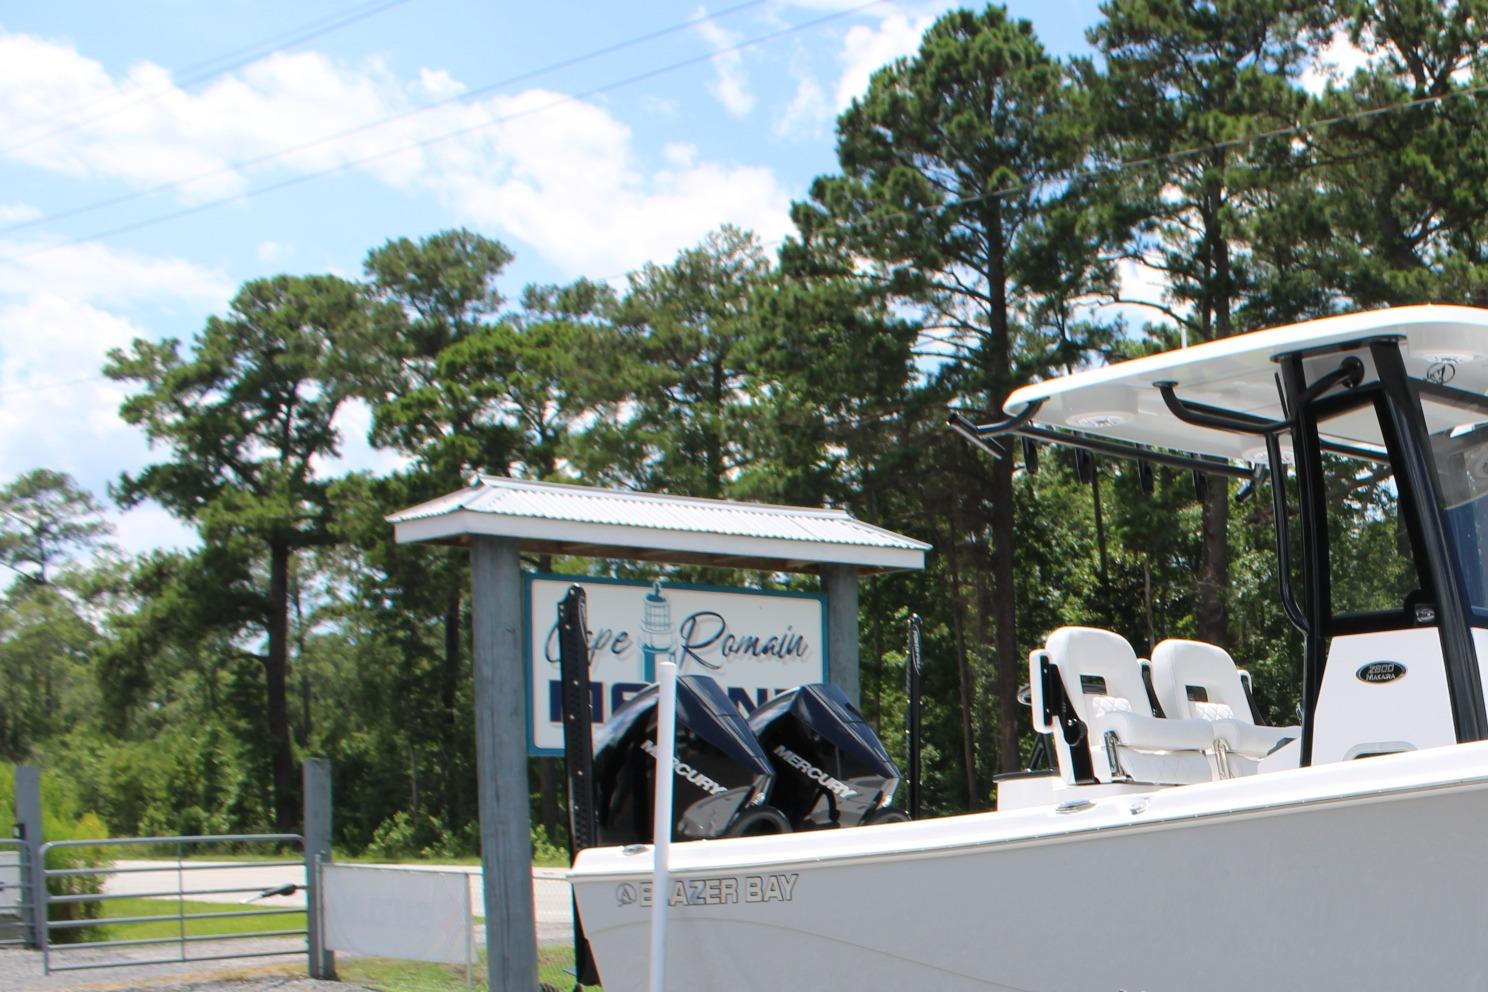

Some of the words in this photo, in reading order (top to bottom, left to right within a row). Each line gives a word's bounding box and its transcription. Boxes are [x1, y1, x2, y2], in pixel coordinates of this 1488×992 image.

[545, 618, 632, 666] Cpe
[679, 610, 808, 670] Romain
[640, 739, 729, 795] MCURY
[773, 745, 858, 799] MERCURY
[640, 877, 739, 908] BAZER
[745, 873, 799, 903] BAY
